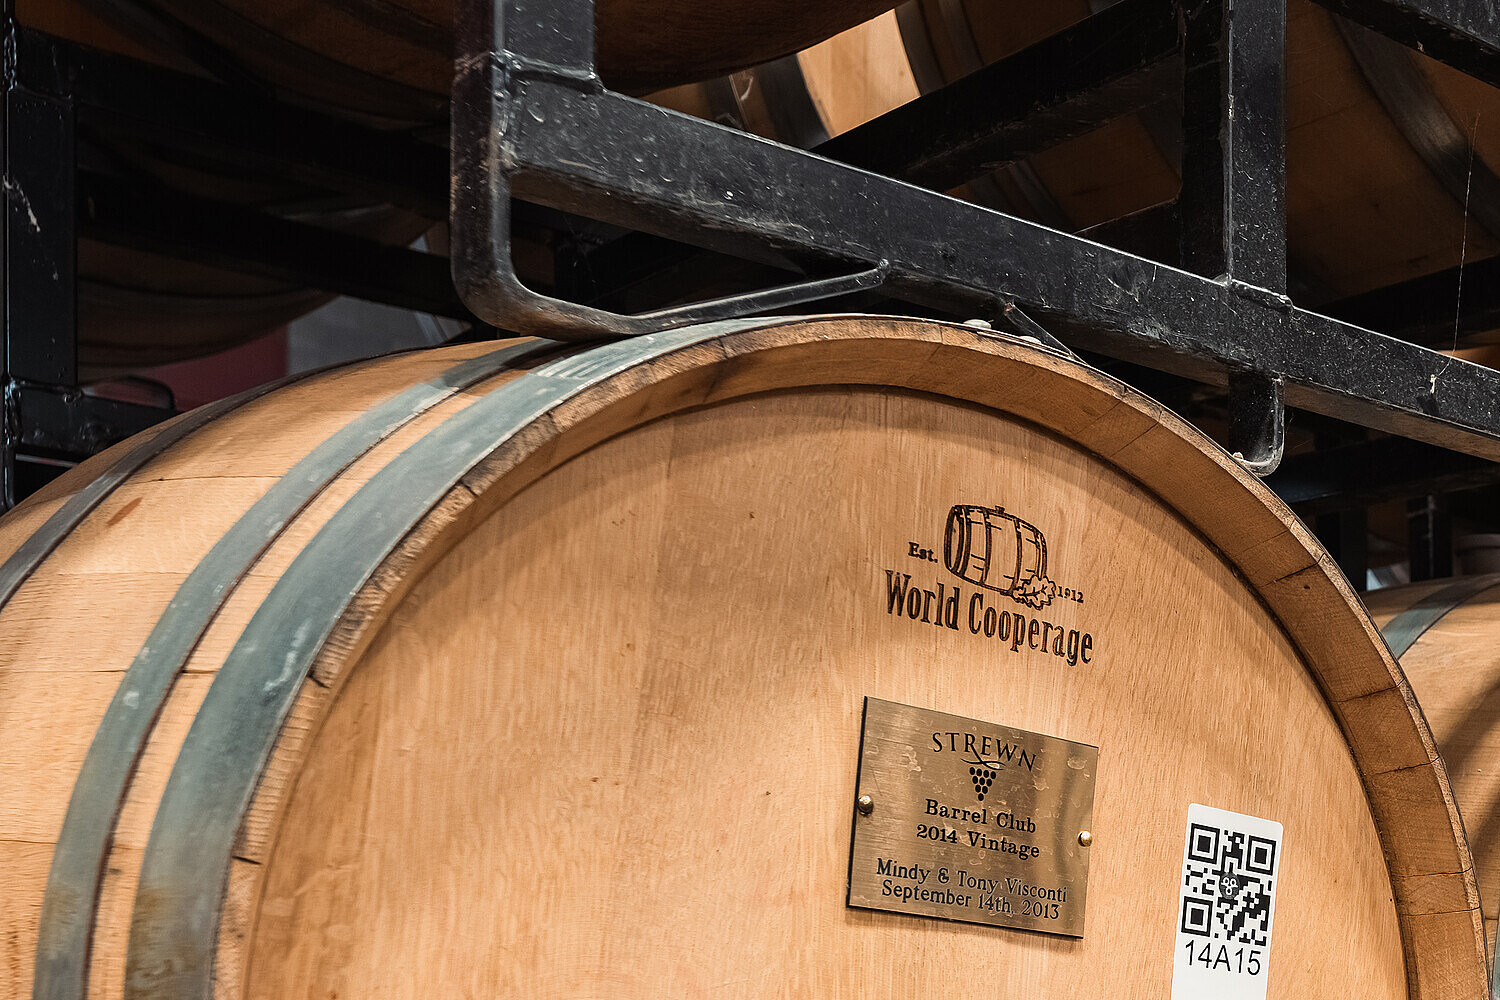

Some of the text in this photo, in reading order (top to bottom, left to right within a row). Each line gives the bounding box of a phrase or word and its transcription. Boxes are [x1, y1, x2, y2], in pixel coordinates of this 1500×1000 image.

[908, 541, 1084, 604] Est. 1912
[885, 569, 1093, 667] World Cooperage
[932, 732, 1037, 772] STREWN
[925, 798, 1036, 834] Barrel Club
[916, 824, 1040, 861] 2014 Vintage
[876, 857, 1067, 903] Mindy & Tony Visconti
[881, 879, 1060, 920] September 14th, 2013
[1185, 939, 1261, 976] 14A15
